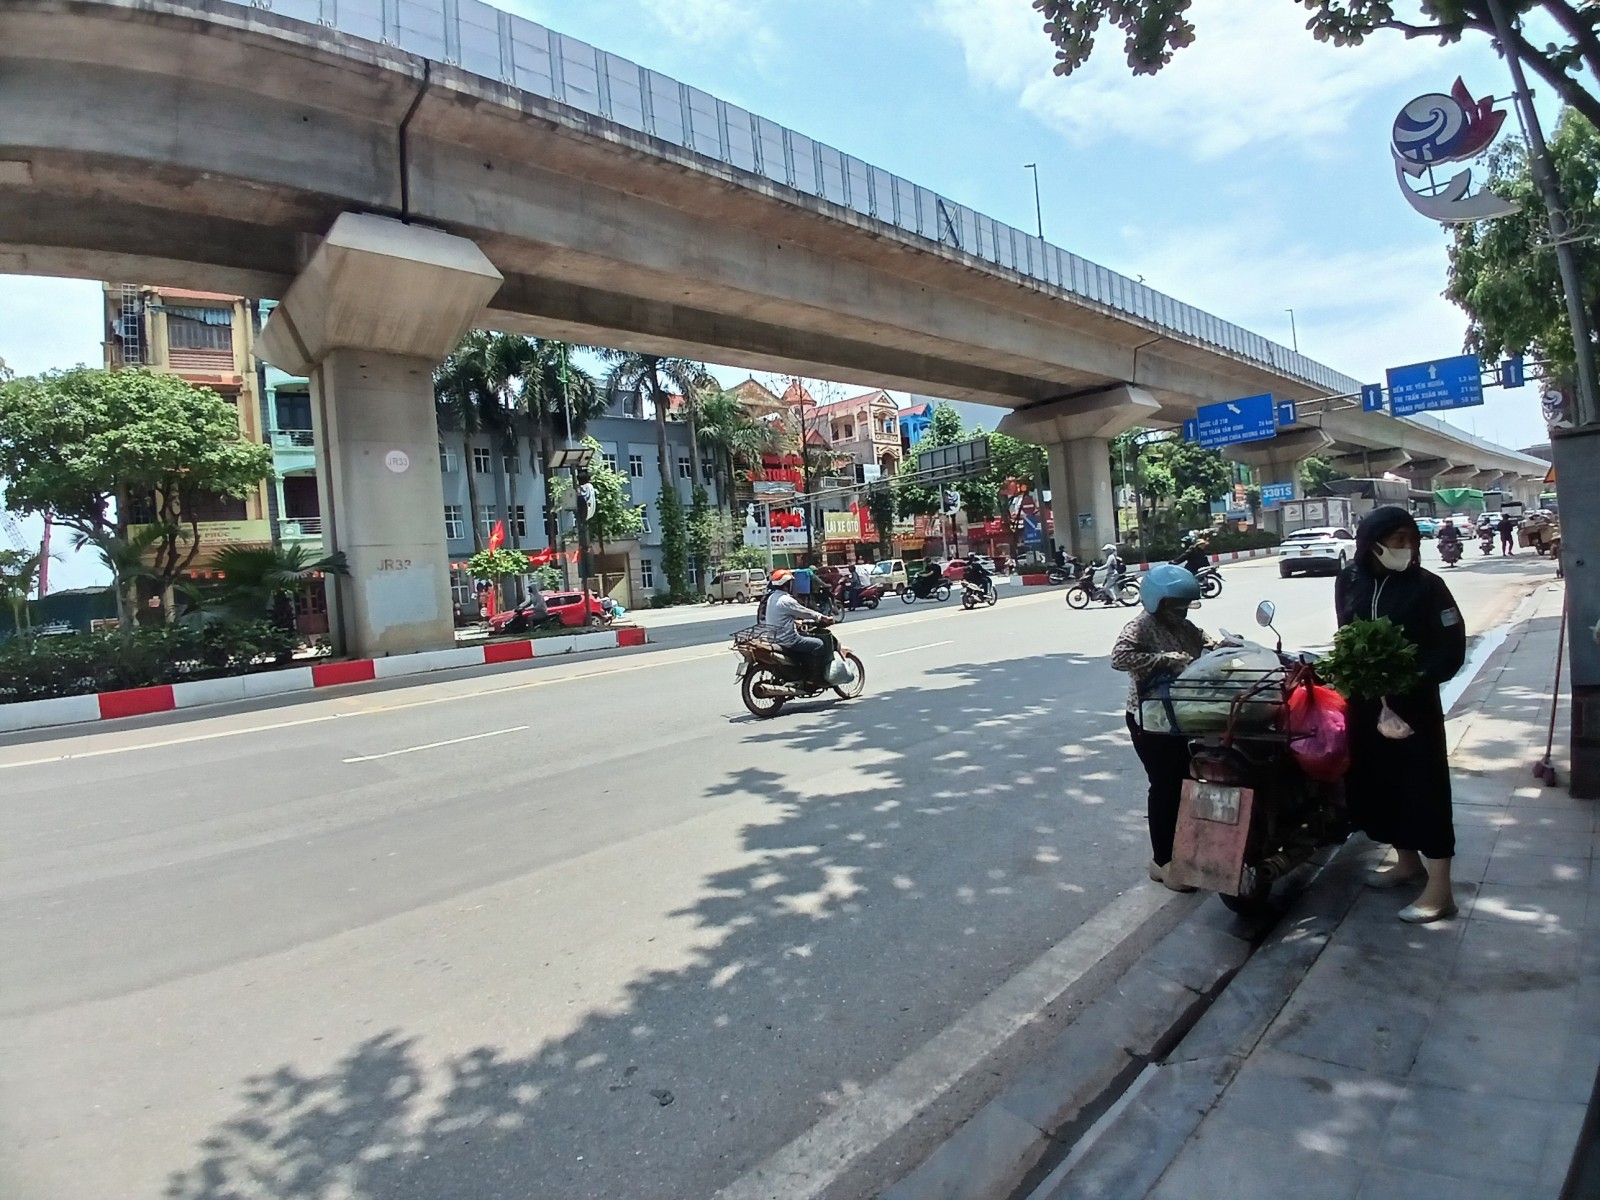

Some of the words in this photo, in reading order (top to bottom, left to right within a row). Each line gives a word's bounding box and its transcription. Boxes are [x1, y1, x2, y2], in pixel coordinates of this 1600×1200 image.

[388, 457, 408, 466] JR33
[1263, 487, 1292, 498] 3301S
[837, 520, 845, 532] XE
